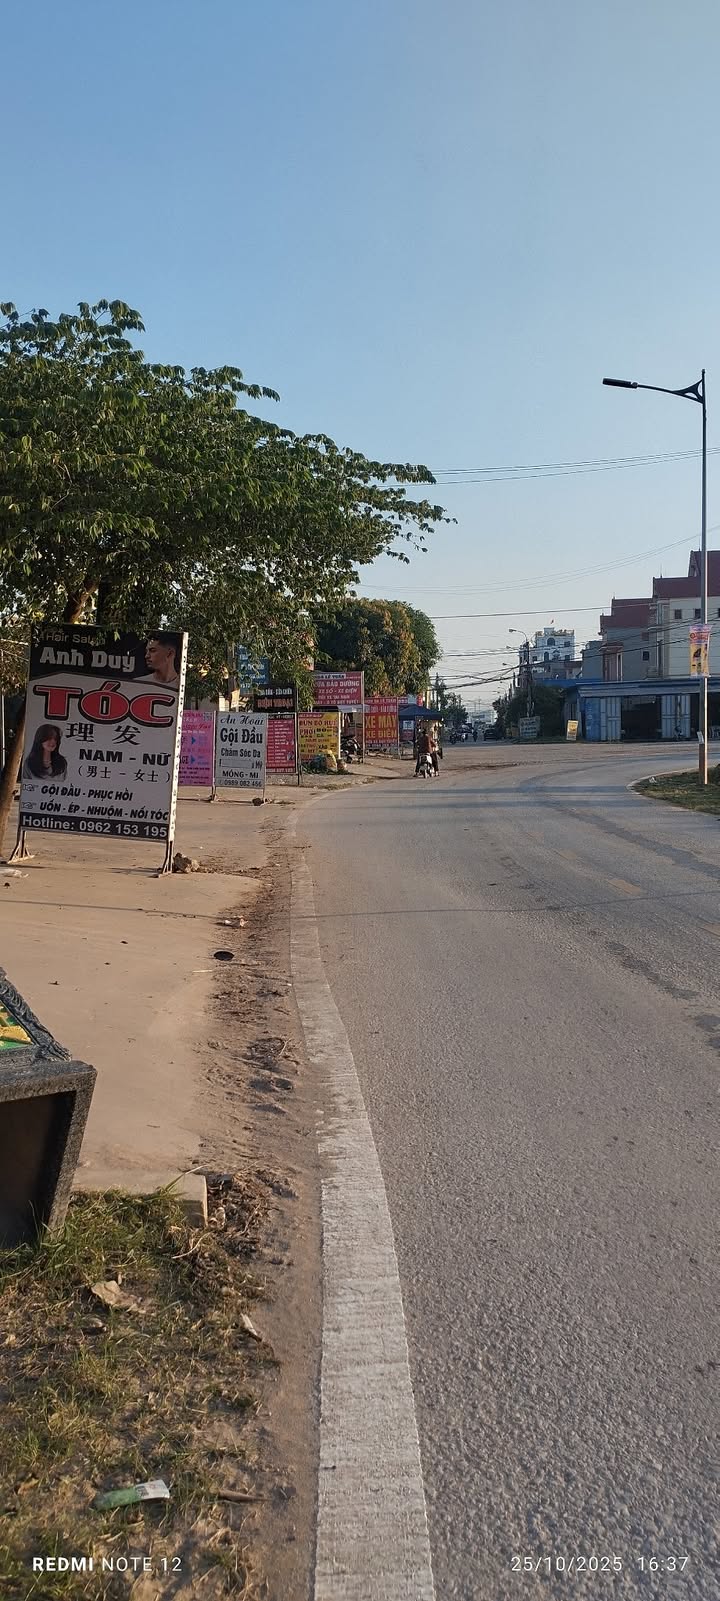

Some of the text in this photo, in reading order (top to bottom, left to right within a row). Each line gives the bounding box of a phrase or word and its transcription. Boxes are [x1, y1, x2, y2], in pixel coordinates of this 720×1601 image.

[46, 631, 69, 642] Hair
[40, 646, 84, 666] Anh
[33, 681, 175, 727] TÓC
[365, 712, 397, 729] XE MÁY
[220, 726, 263, 747] Gội Đầu
[79, 748, 122, 763] NAM
[142, 752, 171, 766] NỮ
[252, 749, 261, 758] Da
[222, 769, 245, 778] MÓNG
[41, 784, 59, 798] GỘI
[61, 783, 81, 797] ĐẦU
[88, 789, 114, 801] PHỤC
[115, 788, 133, 801] HỒI
[40, 799, 61, 812] UỐN
[68, 802, 80, 814] ÉP
[87, 805, 123, 819] NHUỘM
[130, 805, 149, 819] NỐI
[150, 809, 169, 820] TÓC
[23, 815, 167, 838] Hotline: 0962 153 195
